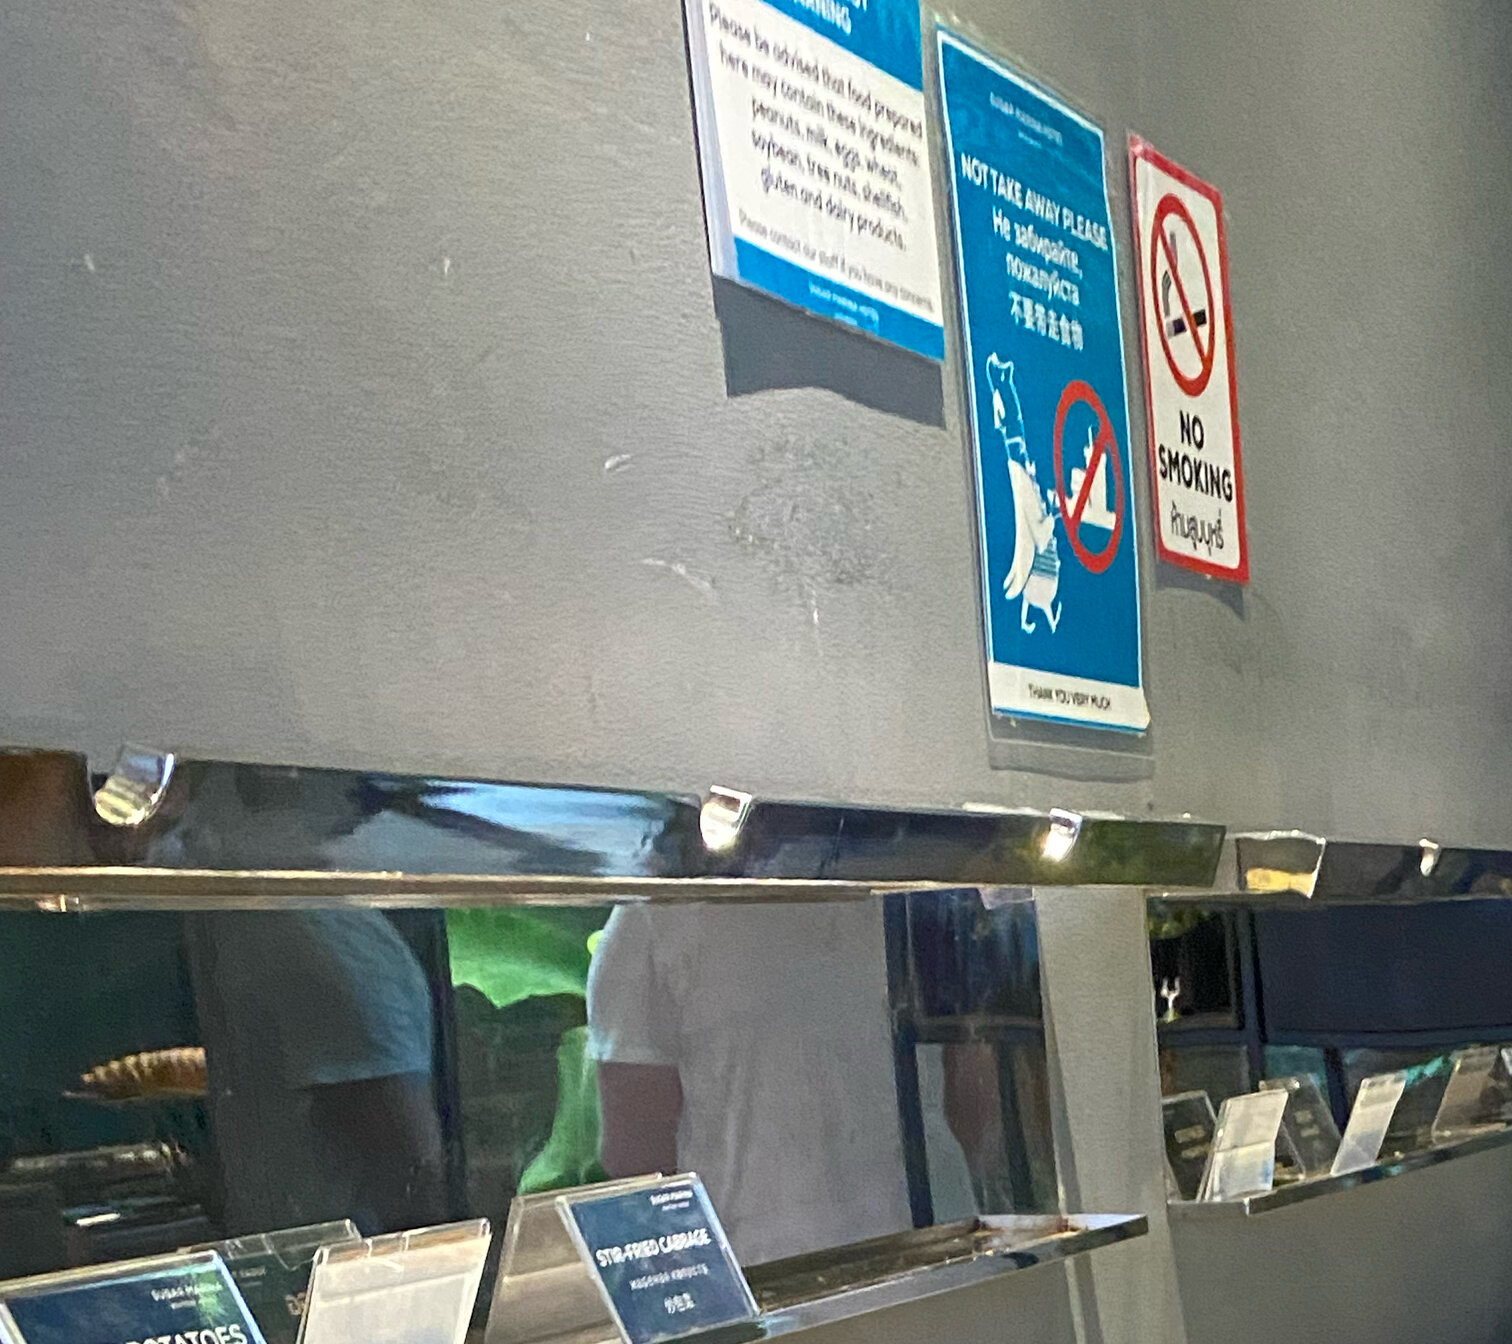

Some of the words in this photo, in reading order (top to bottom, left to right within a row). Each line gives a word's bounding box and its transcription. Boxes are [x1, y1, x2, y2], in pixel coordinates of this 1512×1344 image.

[709, 2, 751, 45] Please
[780, 78, 824, 115] contain
[800, 184, 823, 211] and
[961, 152, 989, 187] NOT
[989, 170, 1022, 209] TAKE
[1025, 188, 1060, 225] AWAY
[1063, 207, 1108, 251] PLEASE
[992, 206, 1011, 241] Не
[1180, 410, 1204, 450] NO
[1159, 443, 1233, 502] SMOKING
